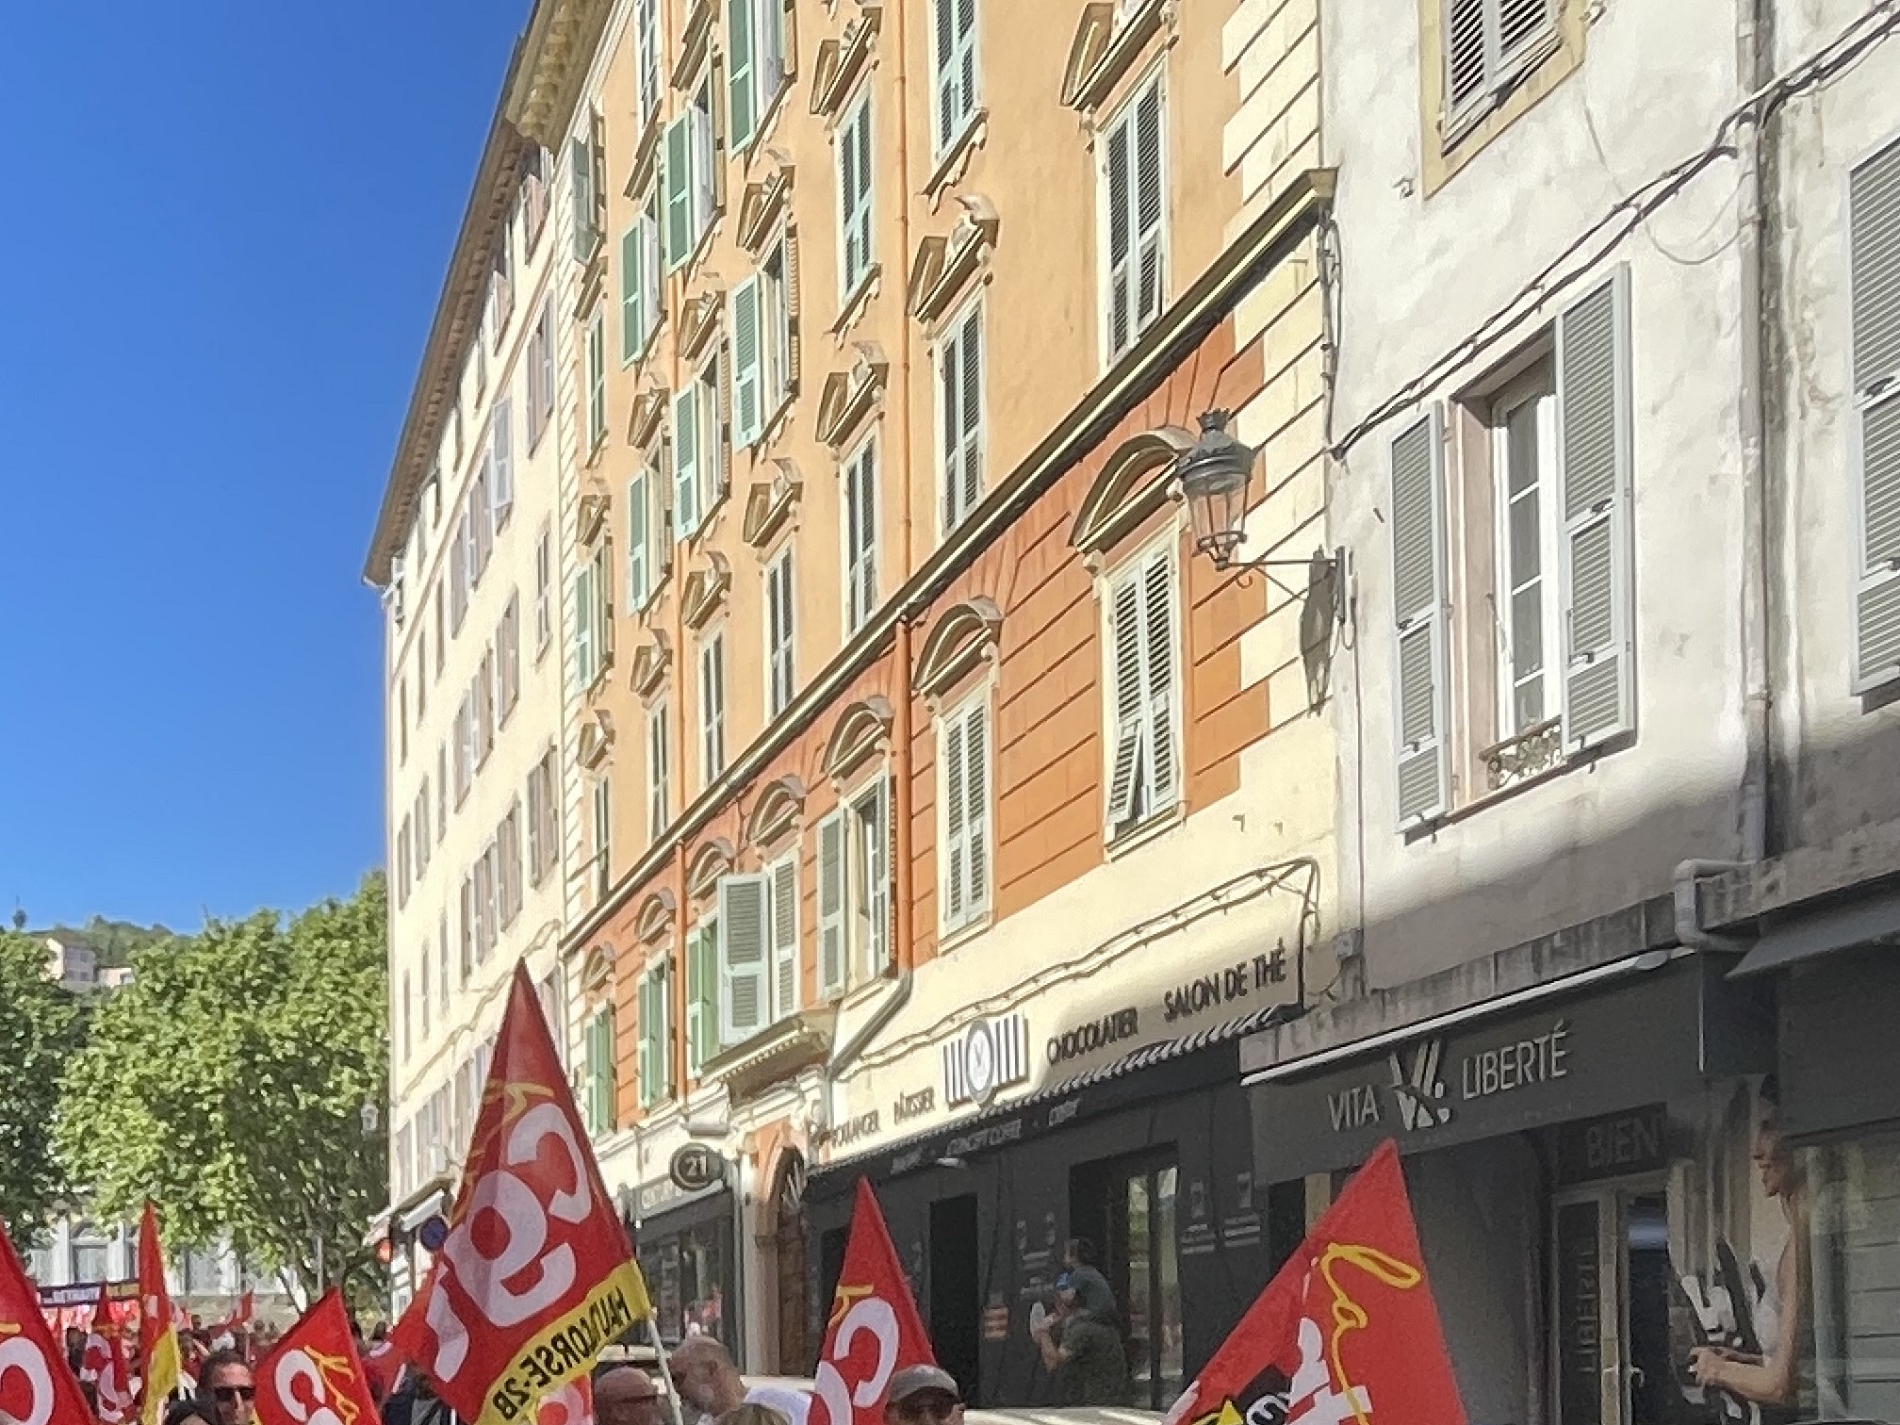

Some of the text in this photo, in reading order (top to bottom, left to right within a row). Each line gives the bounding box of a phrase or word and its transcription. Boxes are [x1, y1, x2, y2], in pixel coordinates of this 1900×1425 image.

[1164, 937, 1287, 1023] SALON DE THÉ
[1327, 1018, 1568, 1132] VITA LIBERTÉ
